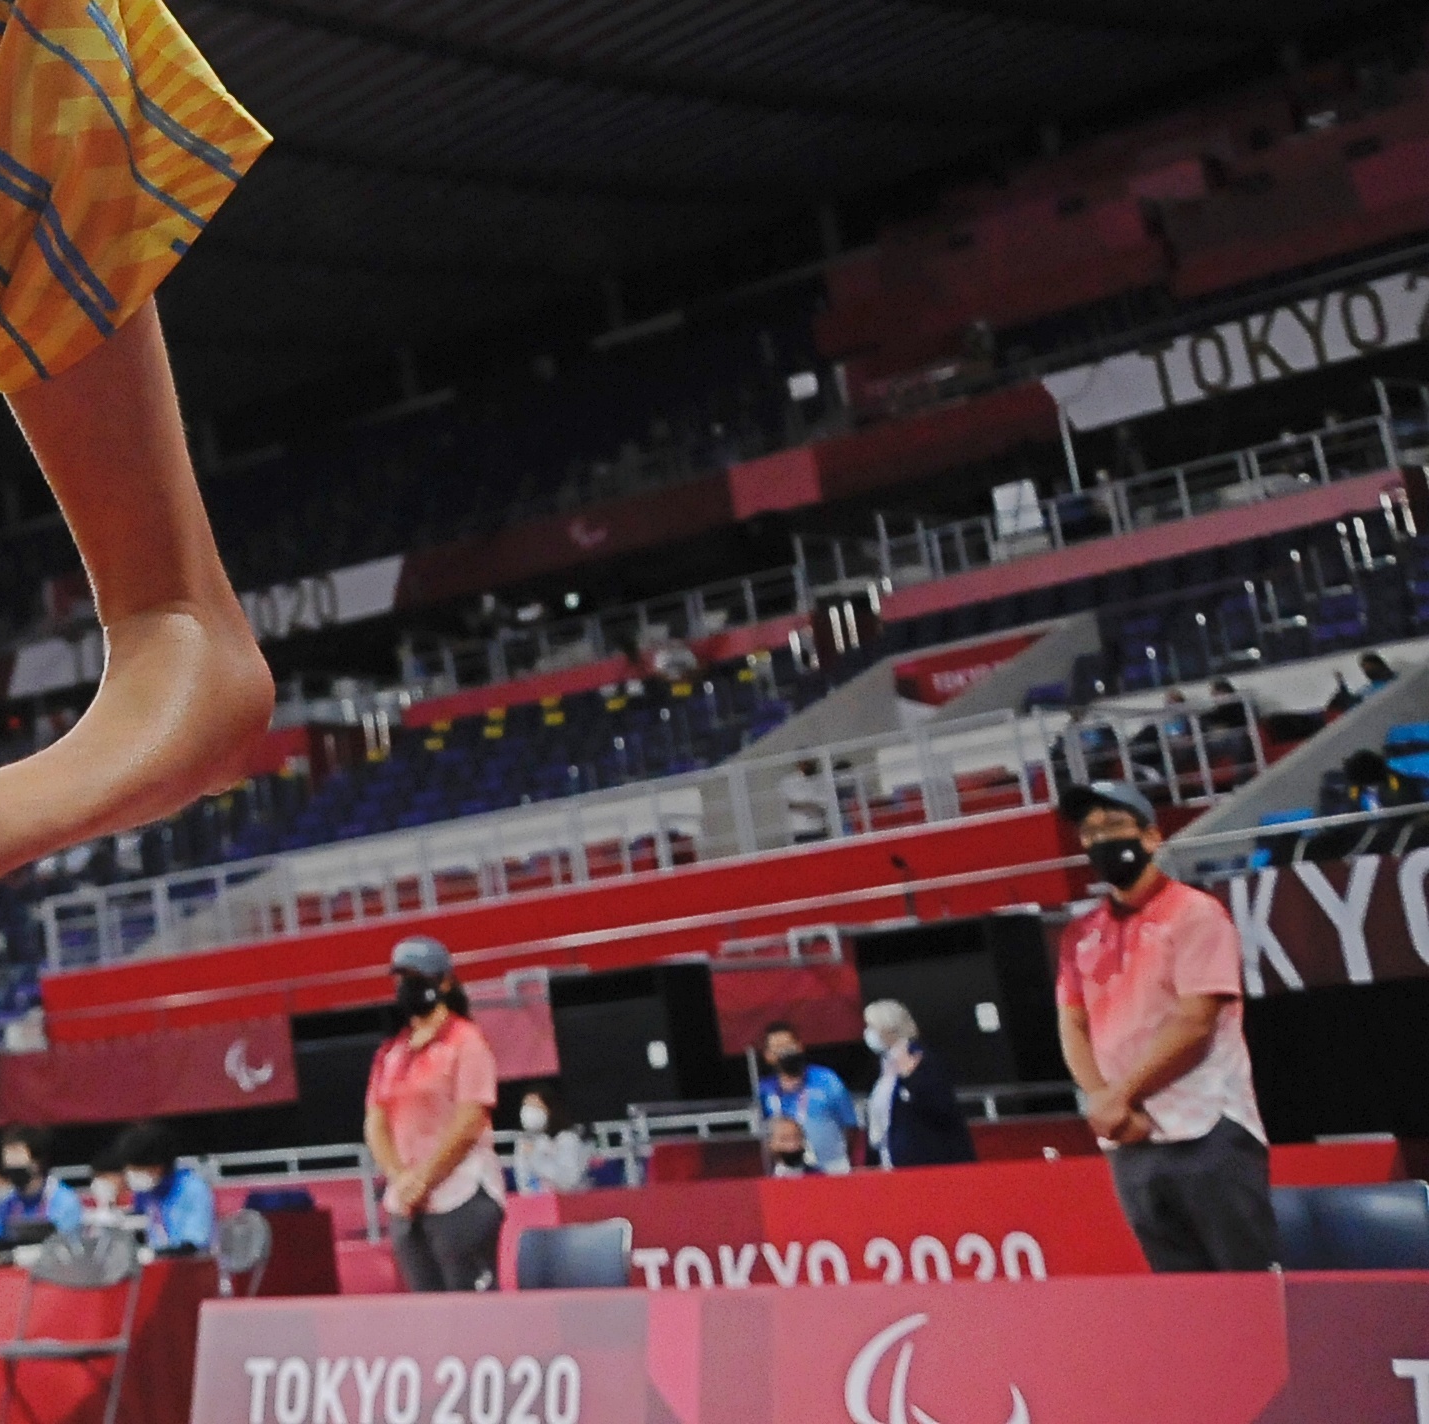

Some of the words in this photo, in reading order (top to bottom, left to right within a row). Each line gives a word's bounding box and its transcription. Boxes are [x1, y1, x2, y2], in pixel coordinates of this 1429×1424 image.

[1137, 284, 1387, 408] TOKYO
[243, 1354, 422, 1424] TOKYO
[430, 1353, 582, 1424] 2020
